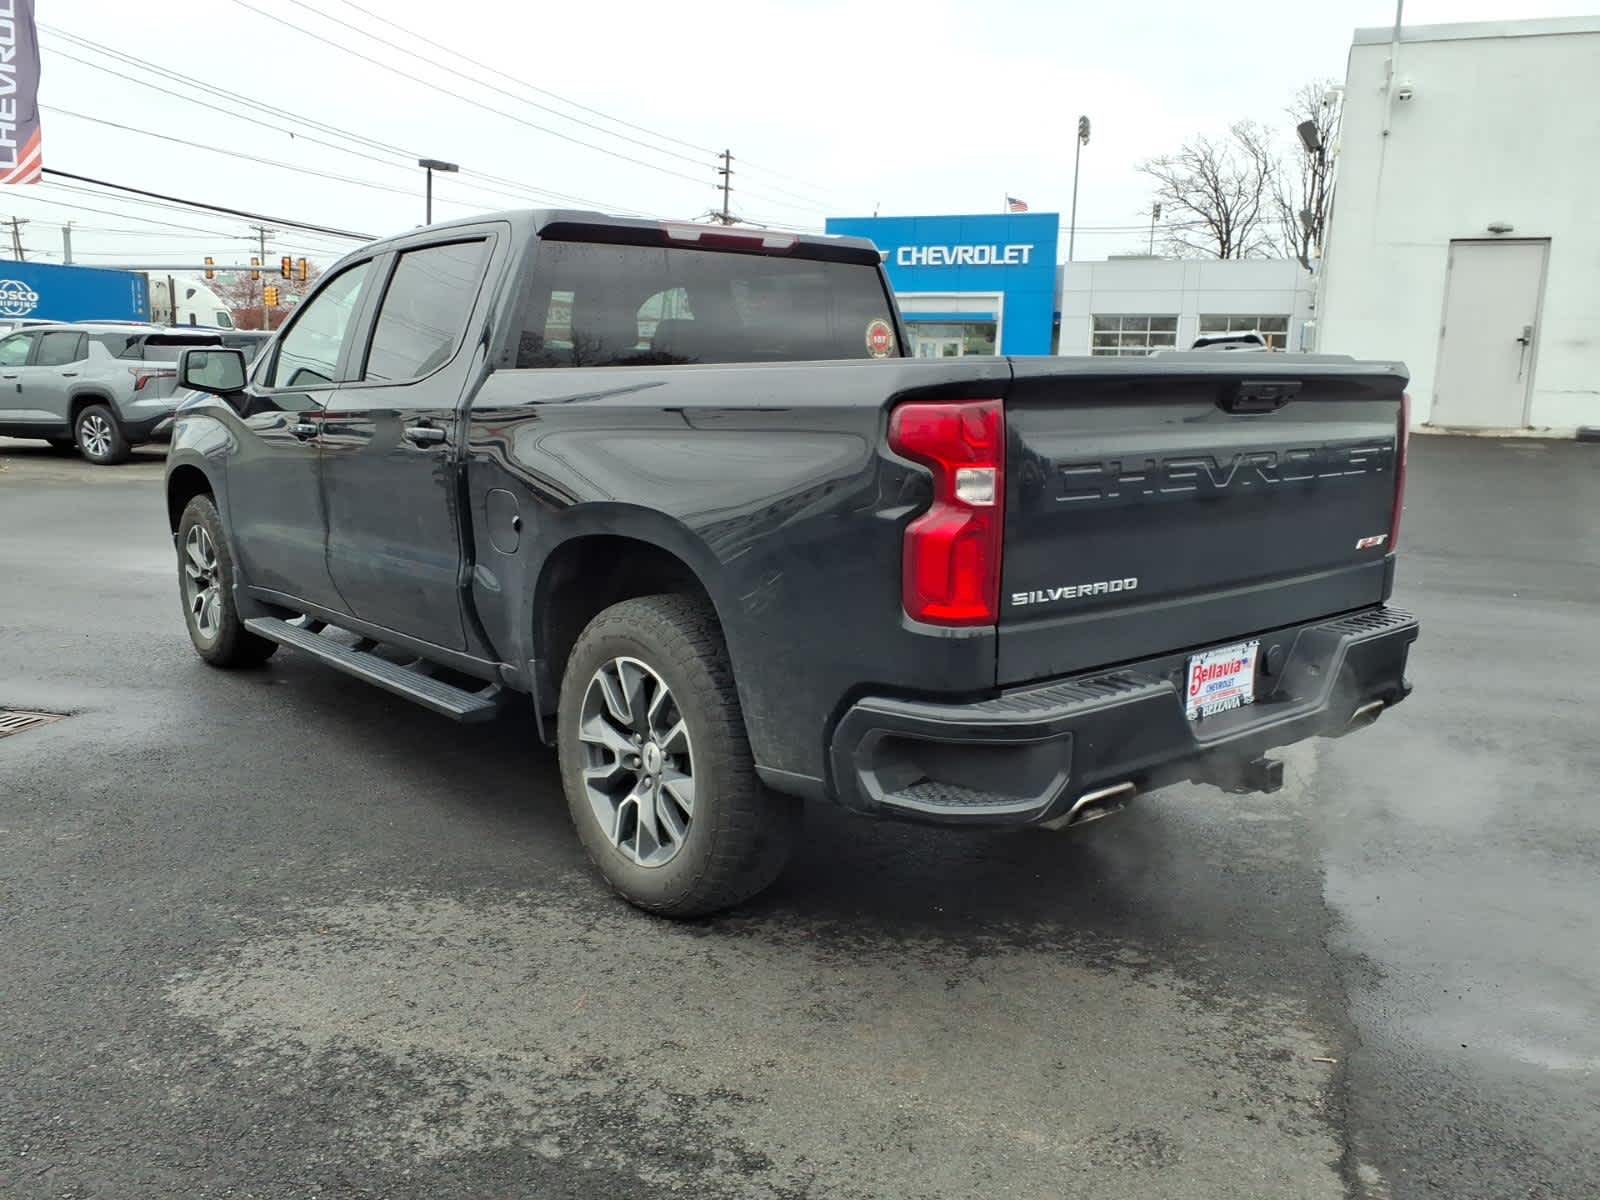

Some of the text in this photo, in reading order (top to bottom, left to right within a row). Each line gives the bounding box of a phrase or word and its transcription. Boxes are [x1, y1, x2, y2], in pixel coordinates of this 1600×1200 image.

[0, 0, 18, 168] CHEVROL
[897, 244, 1035, 266] CHEVROLET
[0, 290, 39, 302] OSCO
[1056, 444, 1393, 502] CHEVROLET
[1011, 577, 1138, 606] SILVERADO
[1190, 659, 1242, 696] Bellavia
